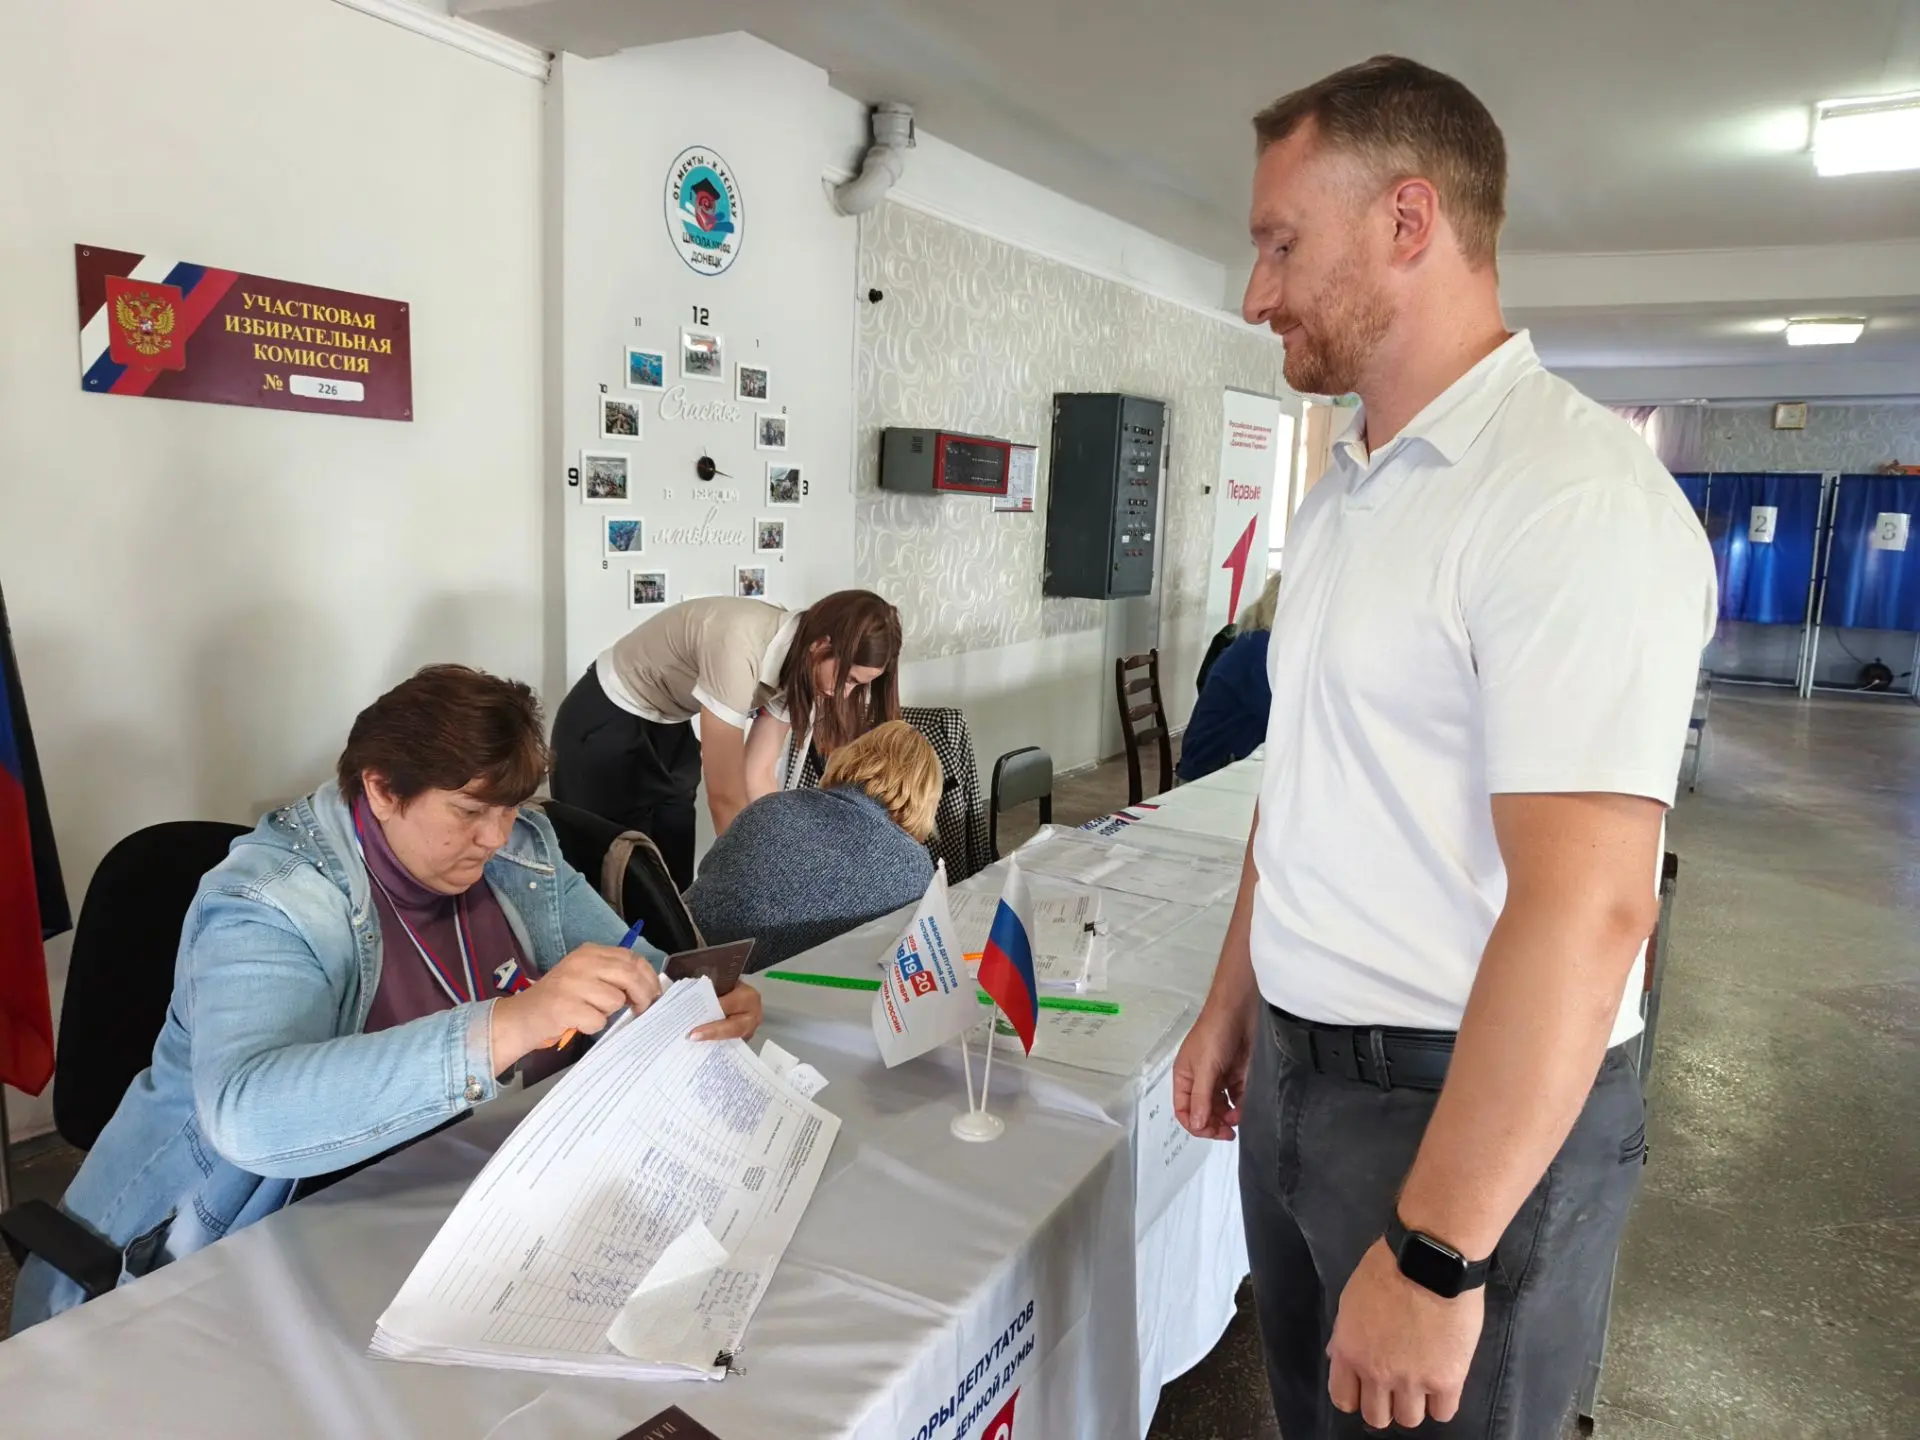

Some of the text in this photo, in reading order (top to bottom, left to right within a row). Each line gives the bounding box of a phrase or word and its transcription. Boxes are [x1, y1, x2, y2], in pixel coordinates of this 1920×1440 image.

[690, 251, 722, 269] ДОНЕЦК
[241, 292, 376, 330] УЧАСТКОВАЯ
[692, 305, 709, 326] 12
[224, 314, 392, 354] ИЗБИРАТЕЛЬНАЯ
[253, 342, 371, 374] КОМИССИЯ
[263, 373, 339, 396] № 226
[567, 467, 580, 487] 9
[802, 480, 809, 496] 3
[1227, 480, 1261, 506] Первые
[1754, 515, 1767, 533] 2
[1882, 521, 1897, 541] 3
[919, 918, 950, 995] ГОСУДАРСТВЕННОЙ ДУМЫ
[928, 916, 958, 989] ВЫБОРЫ ДЕПУТАТОВ
[893, 964, 910, 1004] СЕНТЯБРЯ
[903, 956, 918, 974] 19
[915, 972, 932, 992] 20
[911, 1299, 1035, 1440] ОРЫ ДЕПУТАТОВ
[1001, 1333, 1035, 1389] ДУМЫ
